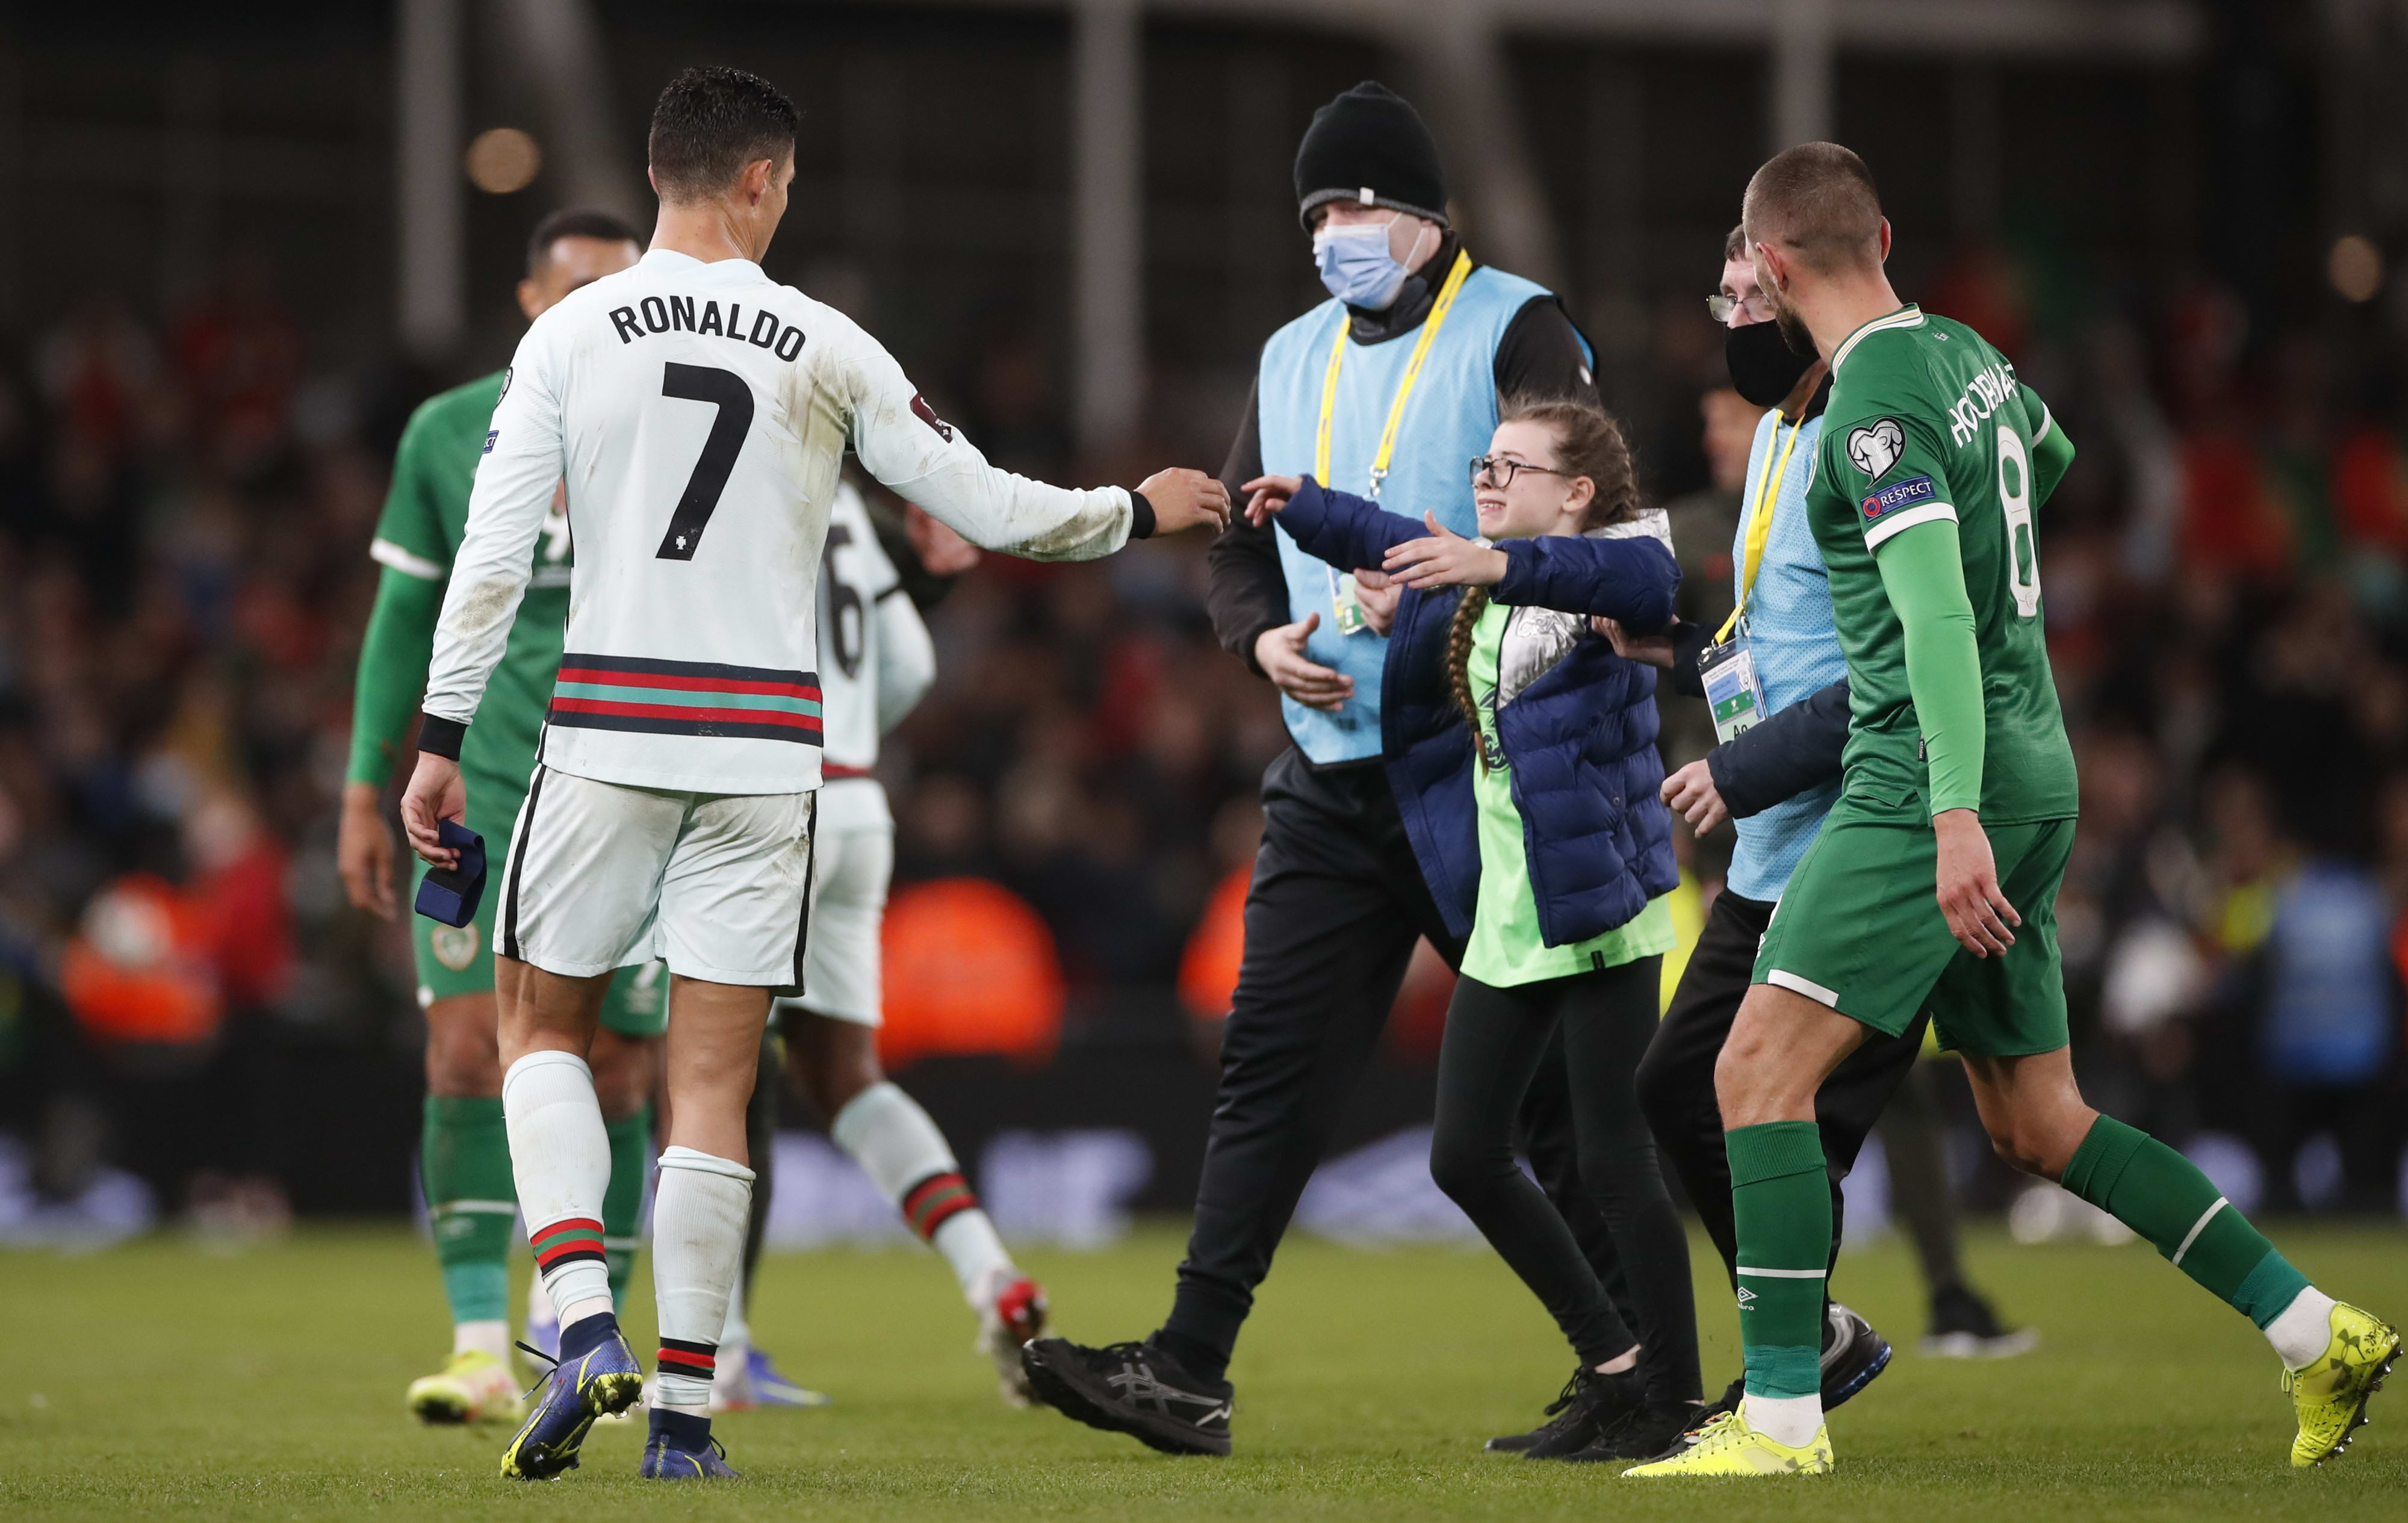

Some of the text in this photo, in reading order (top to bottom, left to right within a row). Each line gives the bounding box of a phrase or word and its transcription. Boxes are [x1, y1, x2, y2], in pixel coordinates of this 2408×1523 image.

[609, 295, 806, 362] RONALDO
[655, 361, 755, 561] 7
[1880, 482, 1931, 507] RESPECT
[1997, 424, 2041, 618] 8
[824, 524, 864, 681] 6
